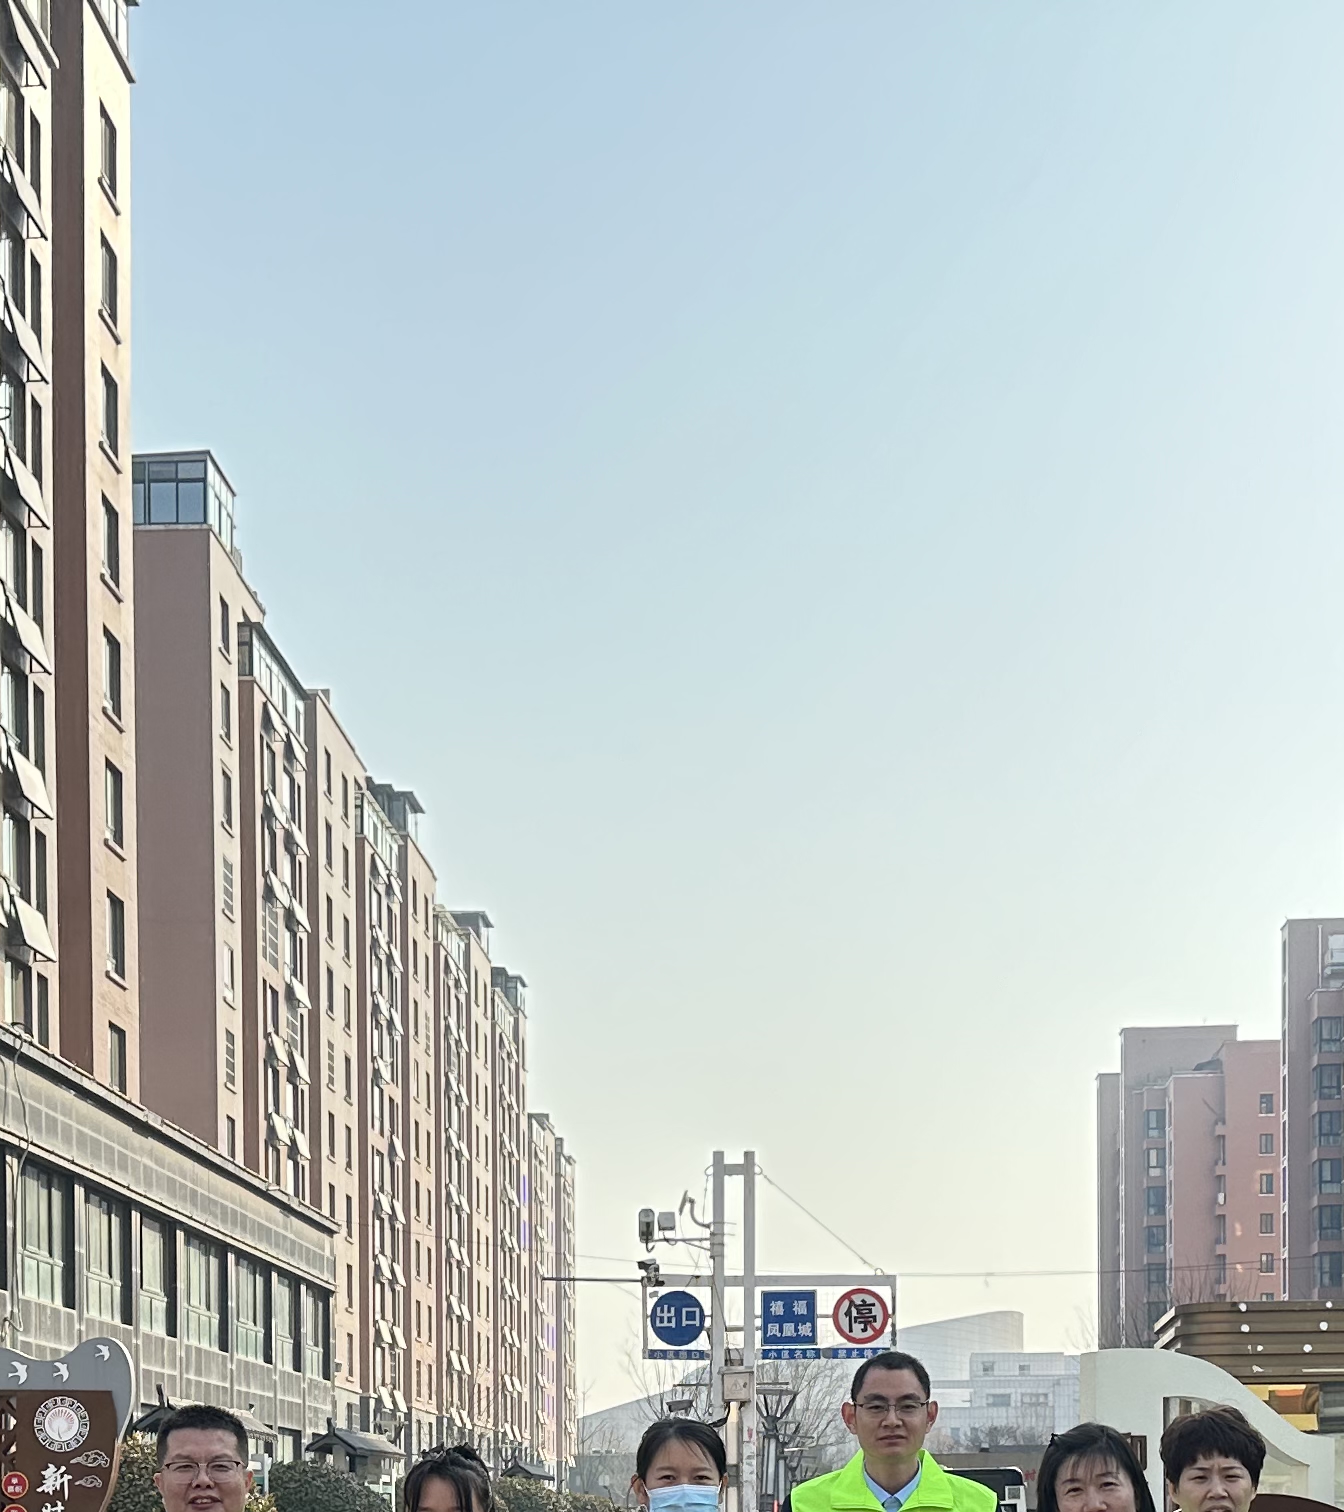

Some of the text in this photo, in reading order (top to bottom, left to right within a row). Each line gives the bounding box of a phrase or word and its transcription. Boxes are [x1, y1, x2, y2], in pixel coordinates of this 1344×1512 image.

[656, 1304, 700, 1328] 出口
[844, 1298, 877, 1333] 停
[766, 1323, 813, 1338] 凤凰城
[767, 1350, 817, 1359] 小区名称
